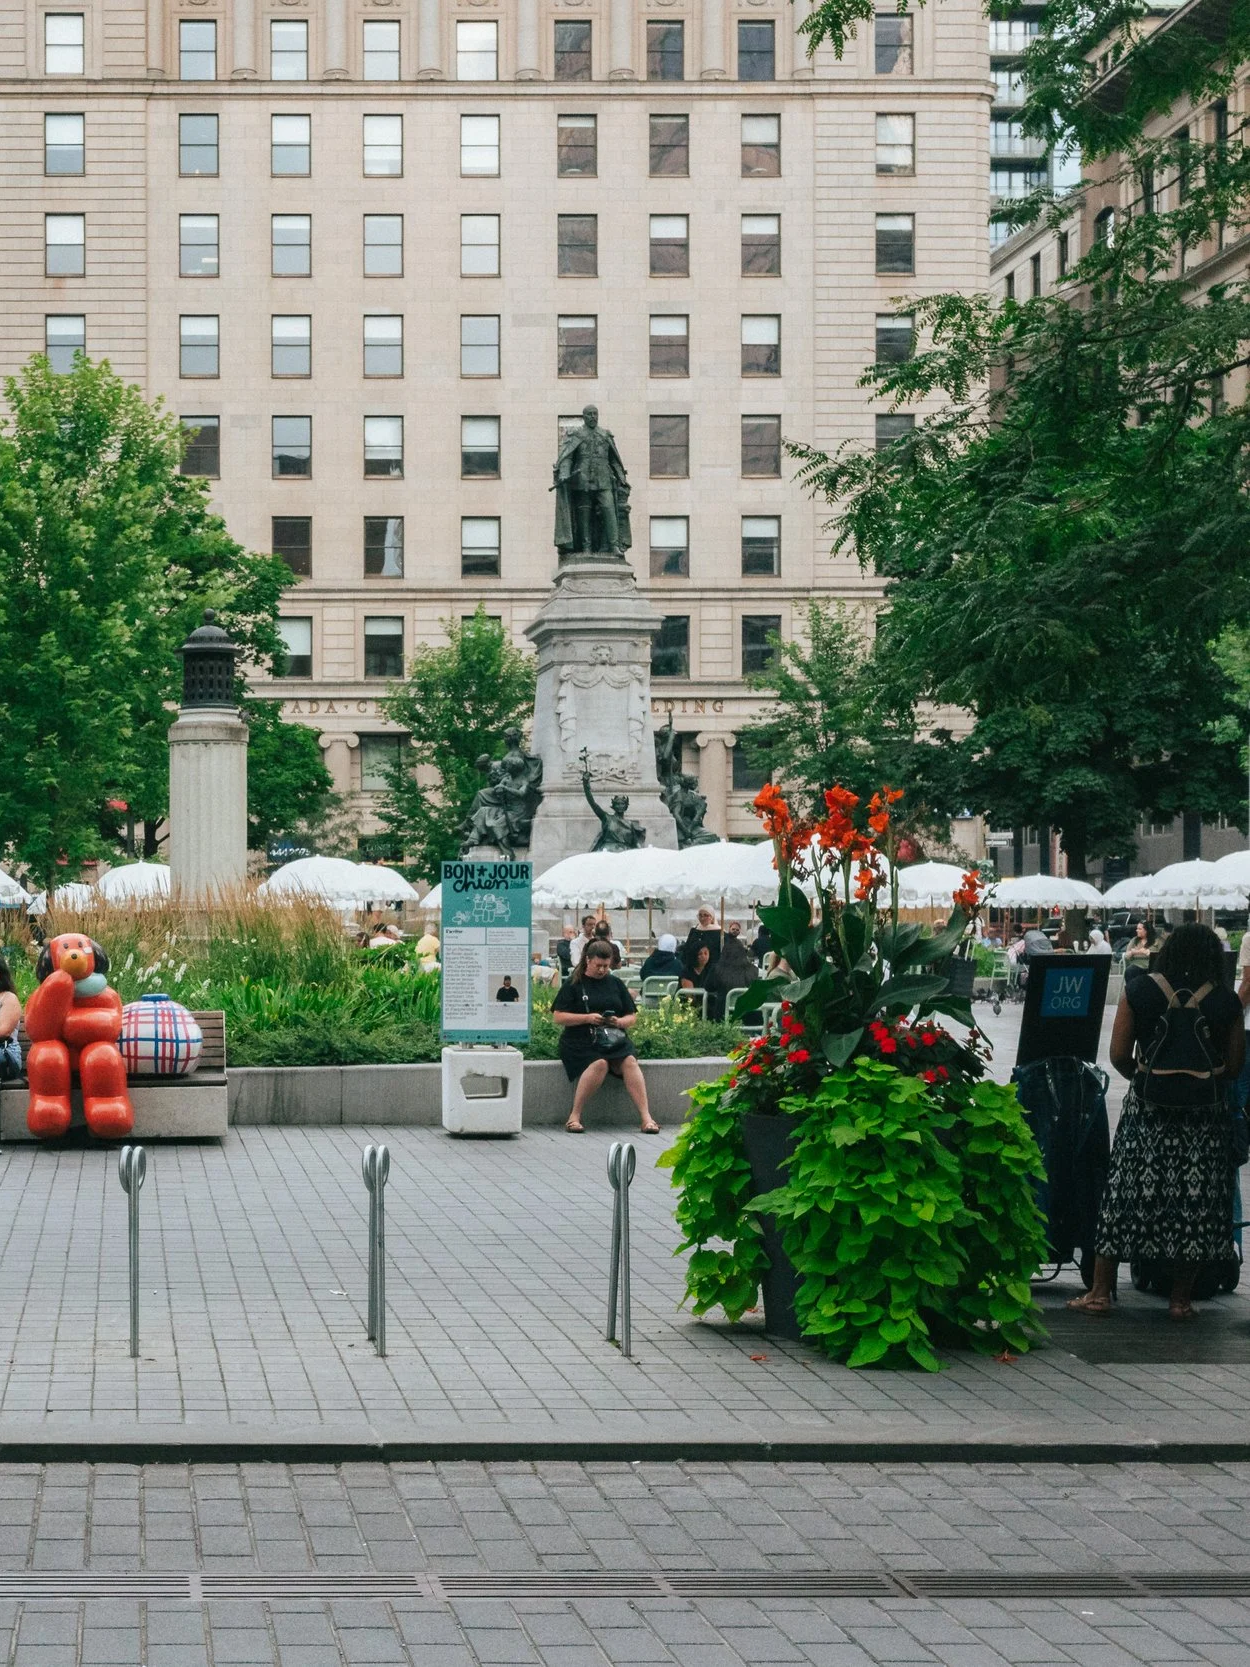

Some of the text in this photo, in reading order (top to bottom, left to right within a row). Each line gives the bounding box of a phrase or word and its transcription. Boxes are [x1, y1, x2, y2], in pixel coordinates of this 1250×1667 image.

[280, 700, 338, 714] ADA
[443, 864, 529, 880] BON JOUR
[453, 878, 509, 893] chien
[1053, 976, 1084, 994] JW
[1050, 996, 1081, 1010] ORG
